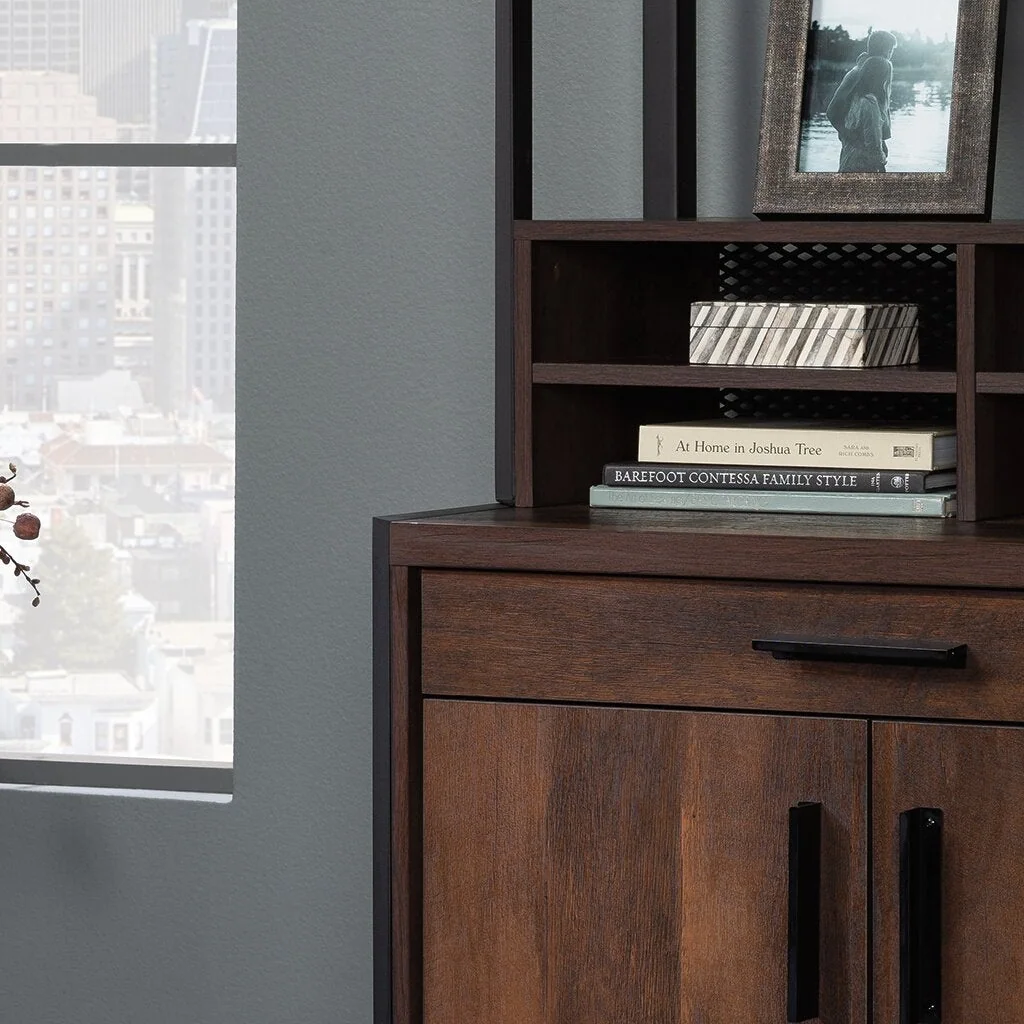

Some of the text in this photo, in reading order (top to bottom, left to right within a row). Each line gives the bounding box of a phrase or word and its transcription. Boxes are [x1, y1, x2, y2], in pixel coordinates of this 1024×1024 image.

[675, 440, 823, 456] At Home in Joshua Tree
[614, 470, 857, 487] BAREFOOT CONTESSA FAMILY STYLE
